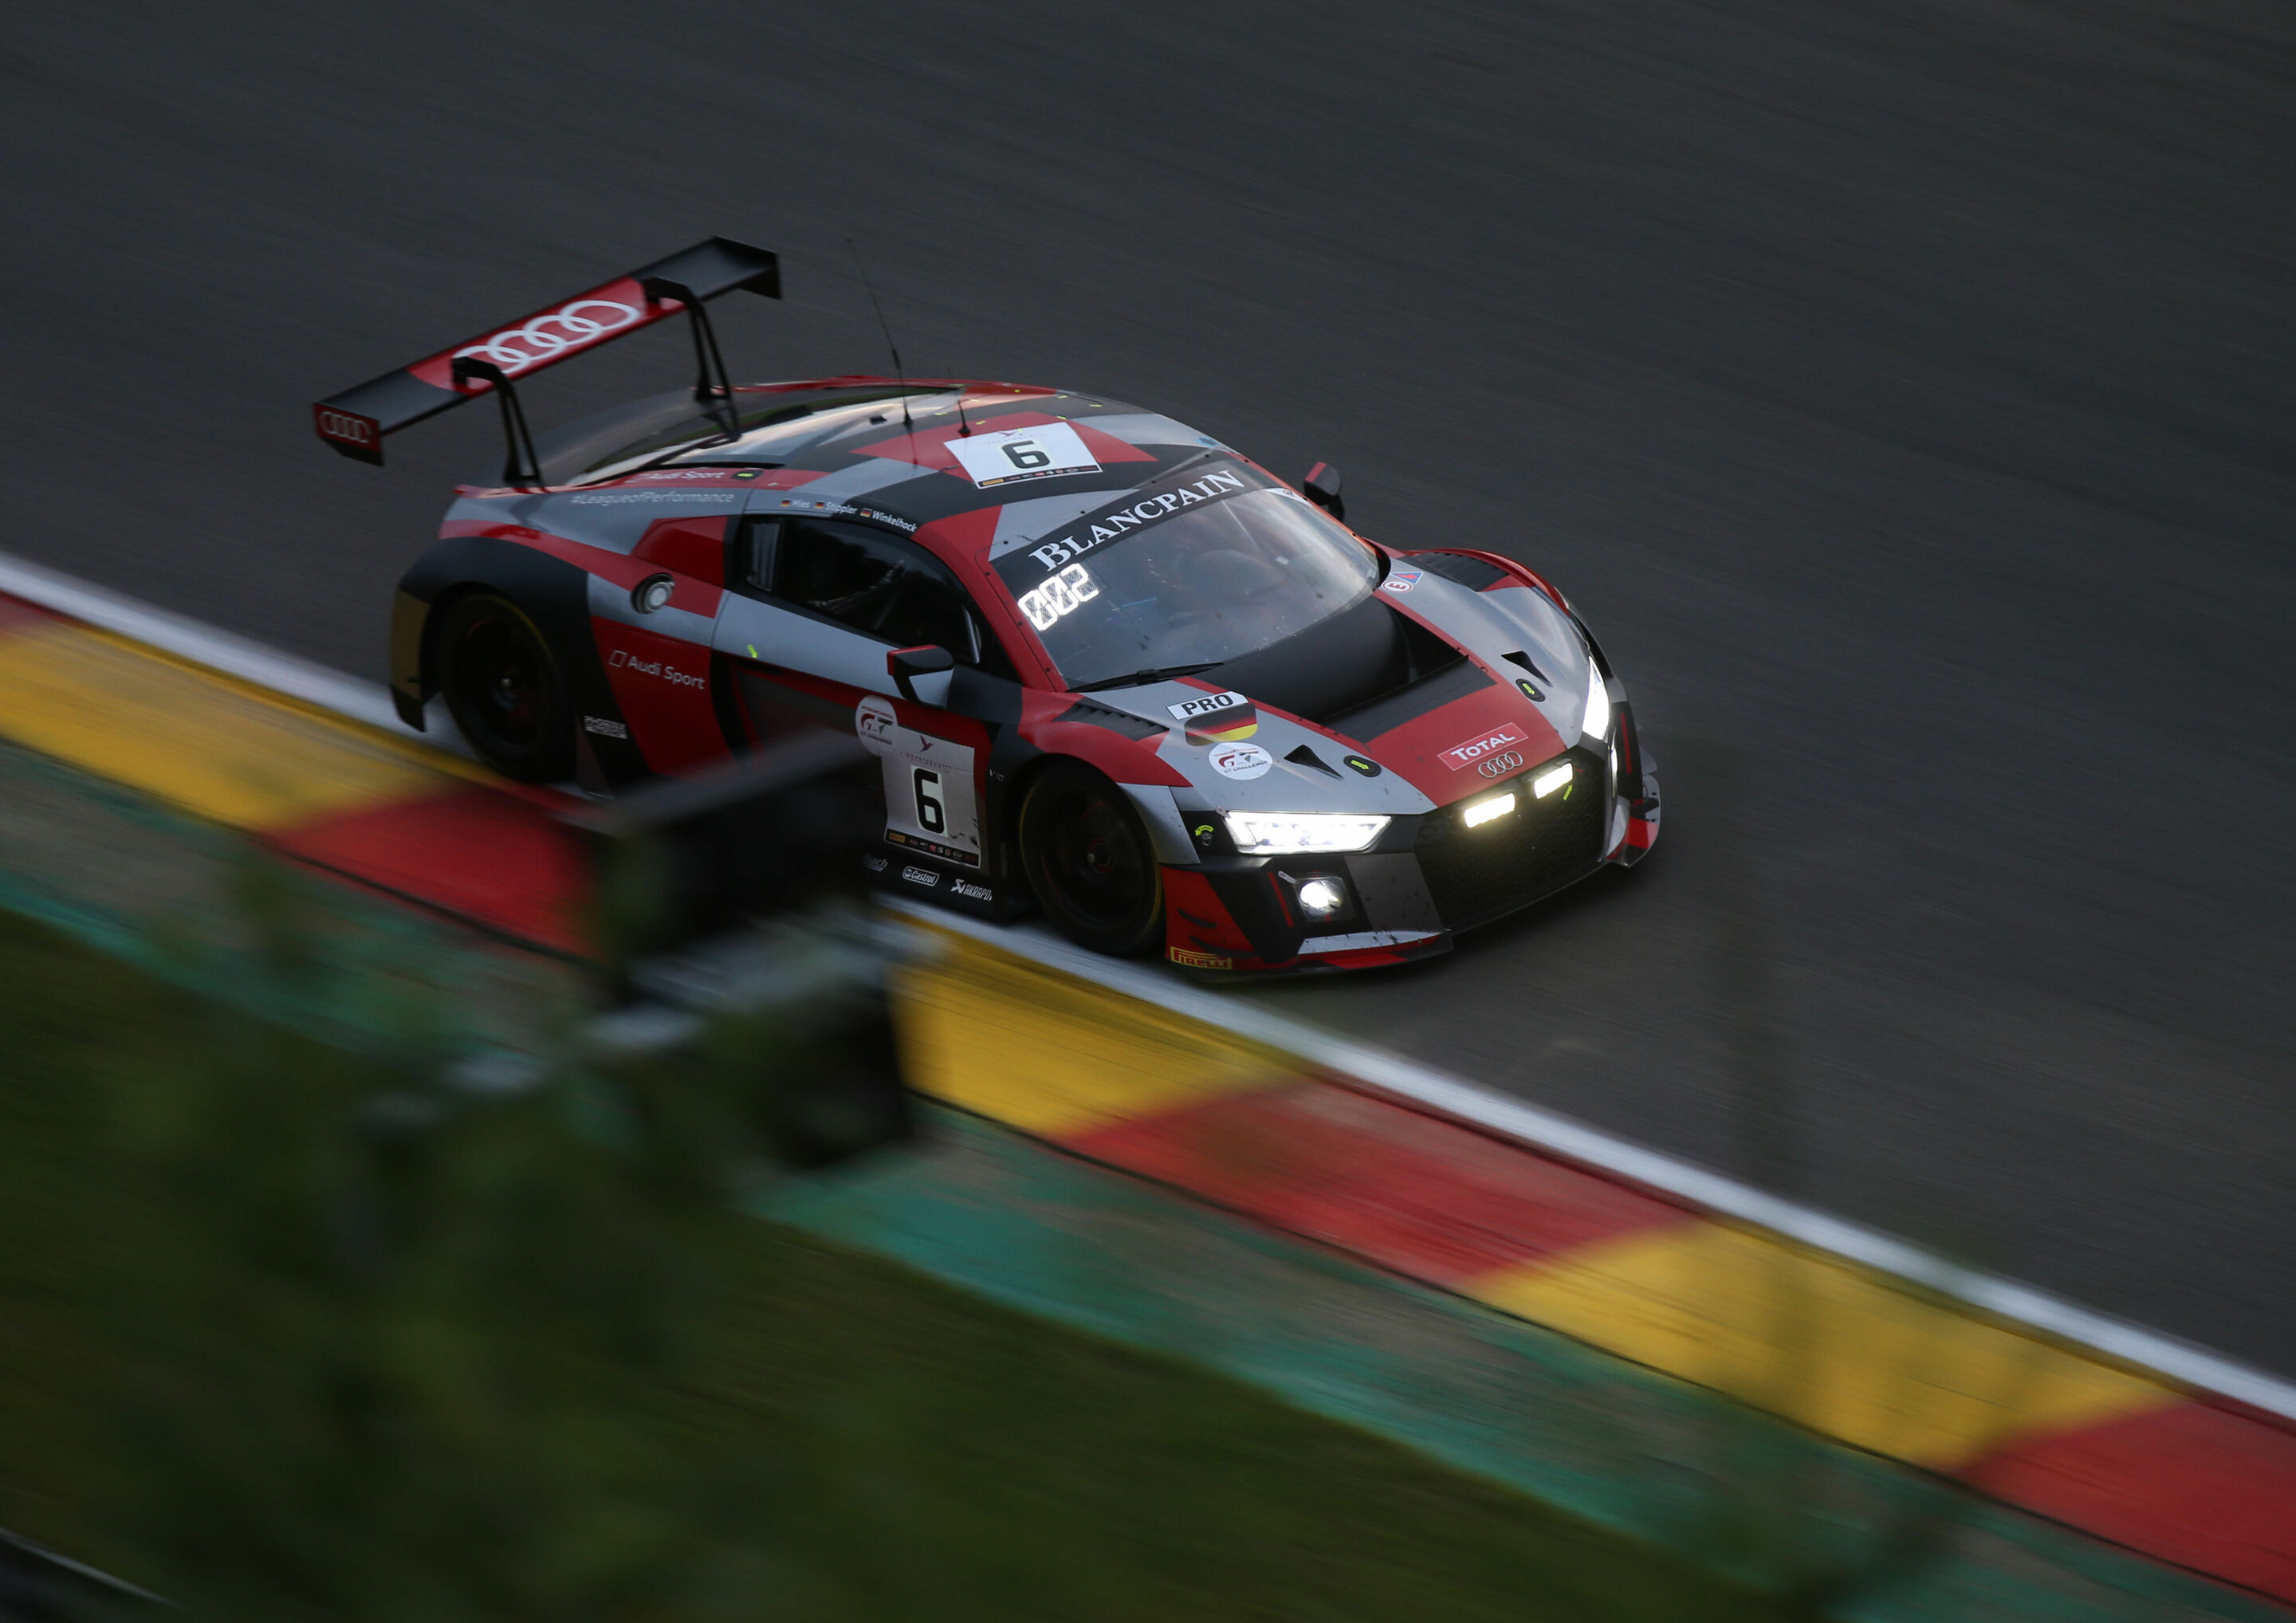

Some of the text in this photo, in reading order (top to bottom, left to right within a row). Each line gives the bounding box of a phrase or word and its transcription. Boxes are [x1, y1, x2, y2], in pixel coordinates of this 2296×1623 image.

[1001, 439, 1051, 470] 6
[871, 509, 918, 533] Winkelhock
[1028, 470, 1246, 572] BLANCPAIN
[1016, 562, 1099, 631] 002
[627, 654, 706, 690] Audi Sport
[1181, 694, 1234, 716] PRO
[1450, 733, 1516, 761] TOTAL
[913, 768, 945, 835] 6
[910, 869, 936, 885] Castrol
[1173, 949, 1229, 969] PIRELLI
